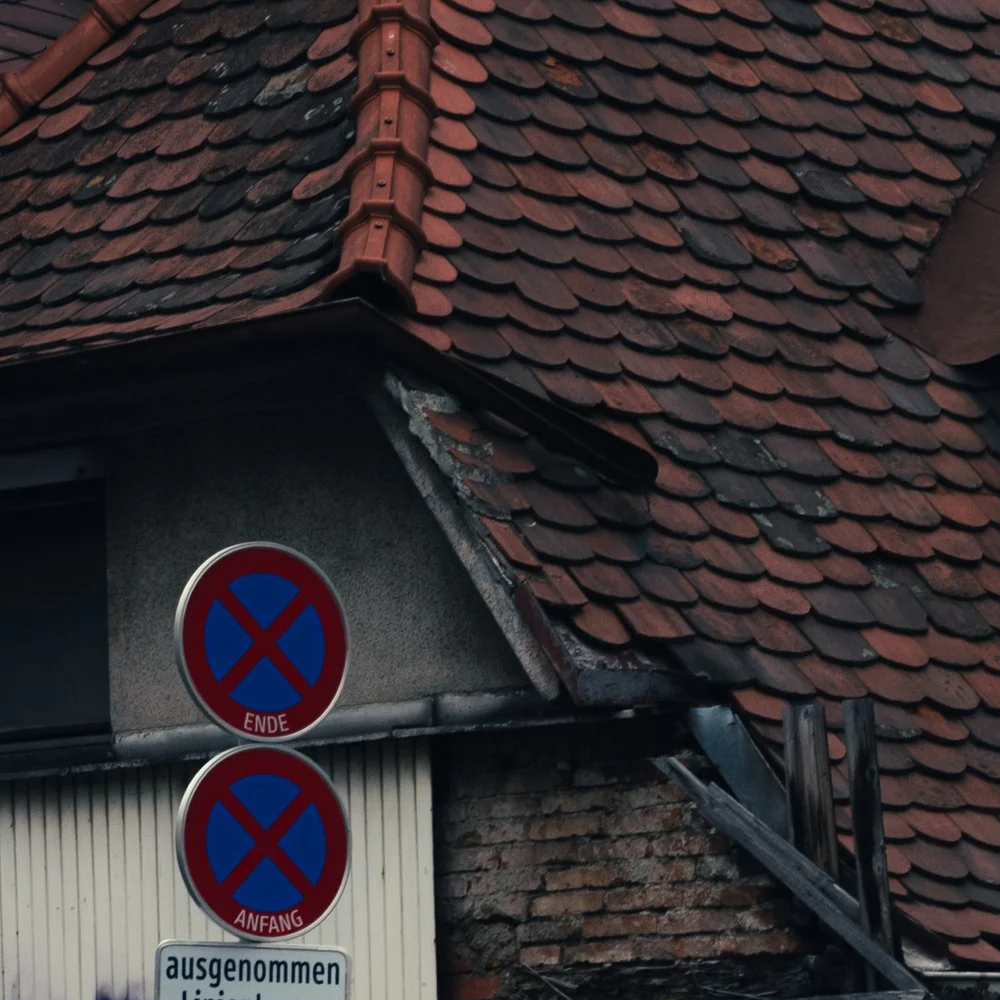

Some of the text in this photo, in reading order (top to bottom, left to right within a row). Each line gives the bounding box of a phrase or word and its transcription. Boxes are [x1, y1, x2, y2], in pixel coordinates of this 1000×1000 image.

[244, 712, 290, 734] ENDE
[233, 909, 304, 934] ANFANG
[166, 956, 340, 988] ausgenommen
